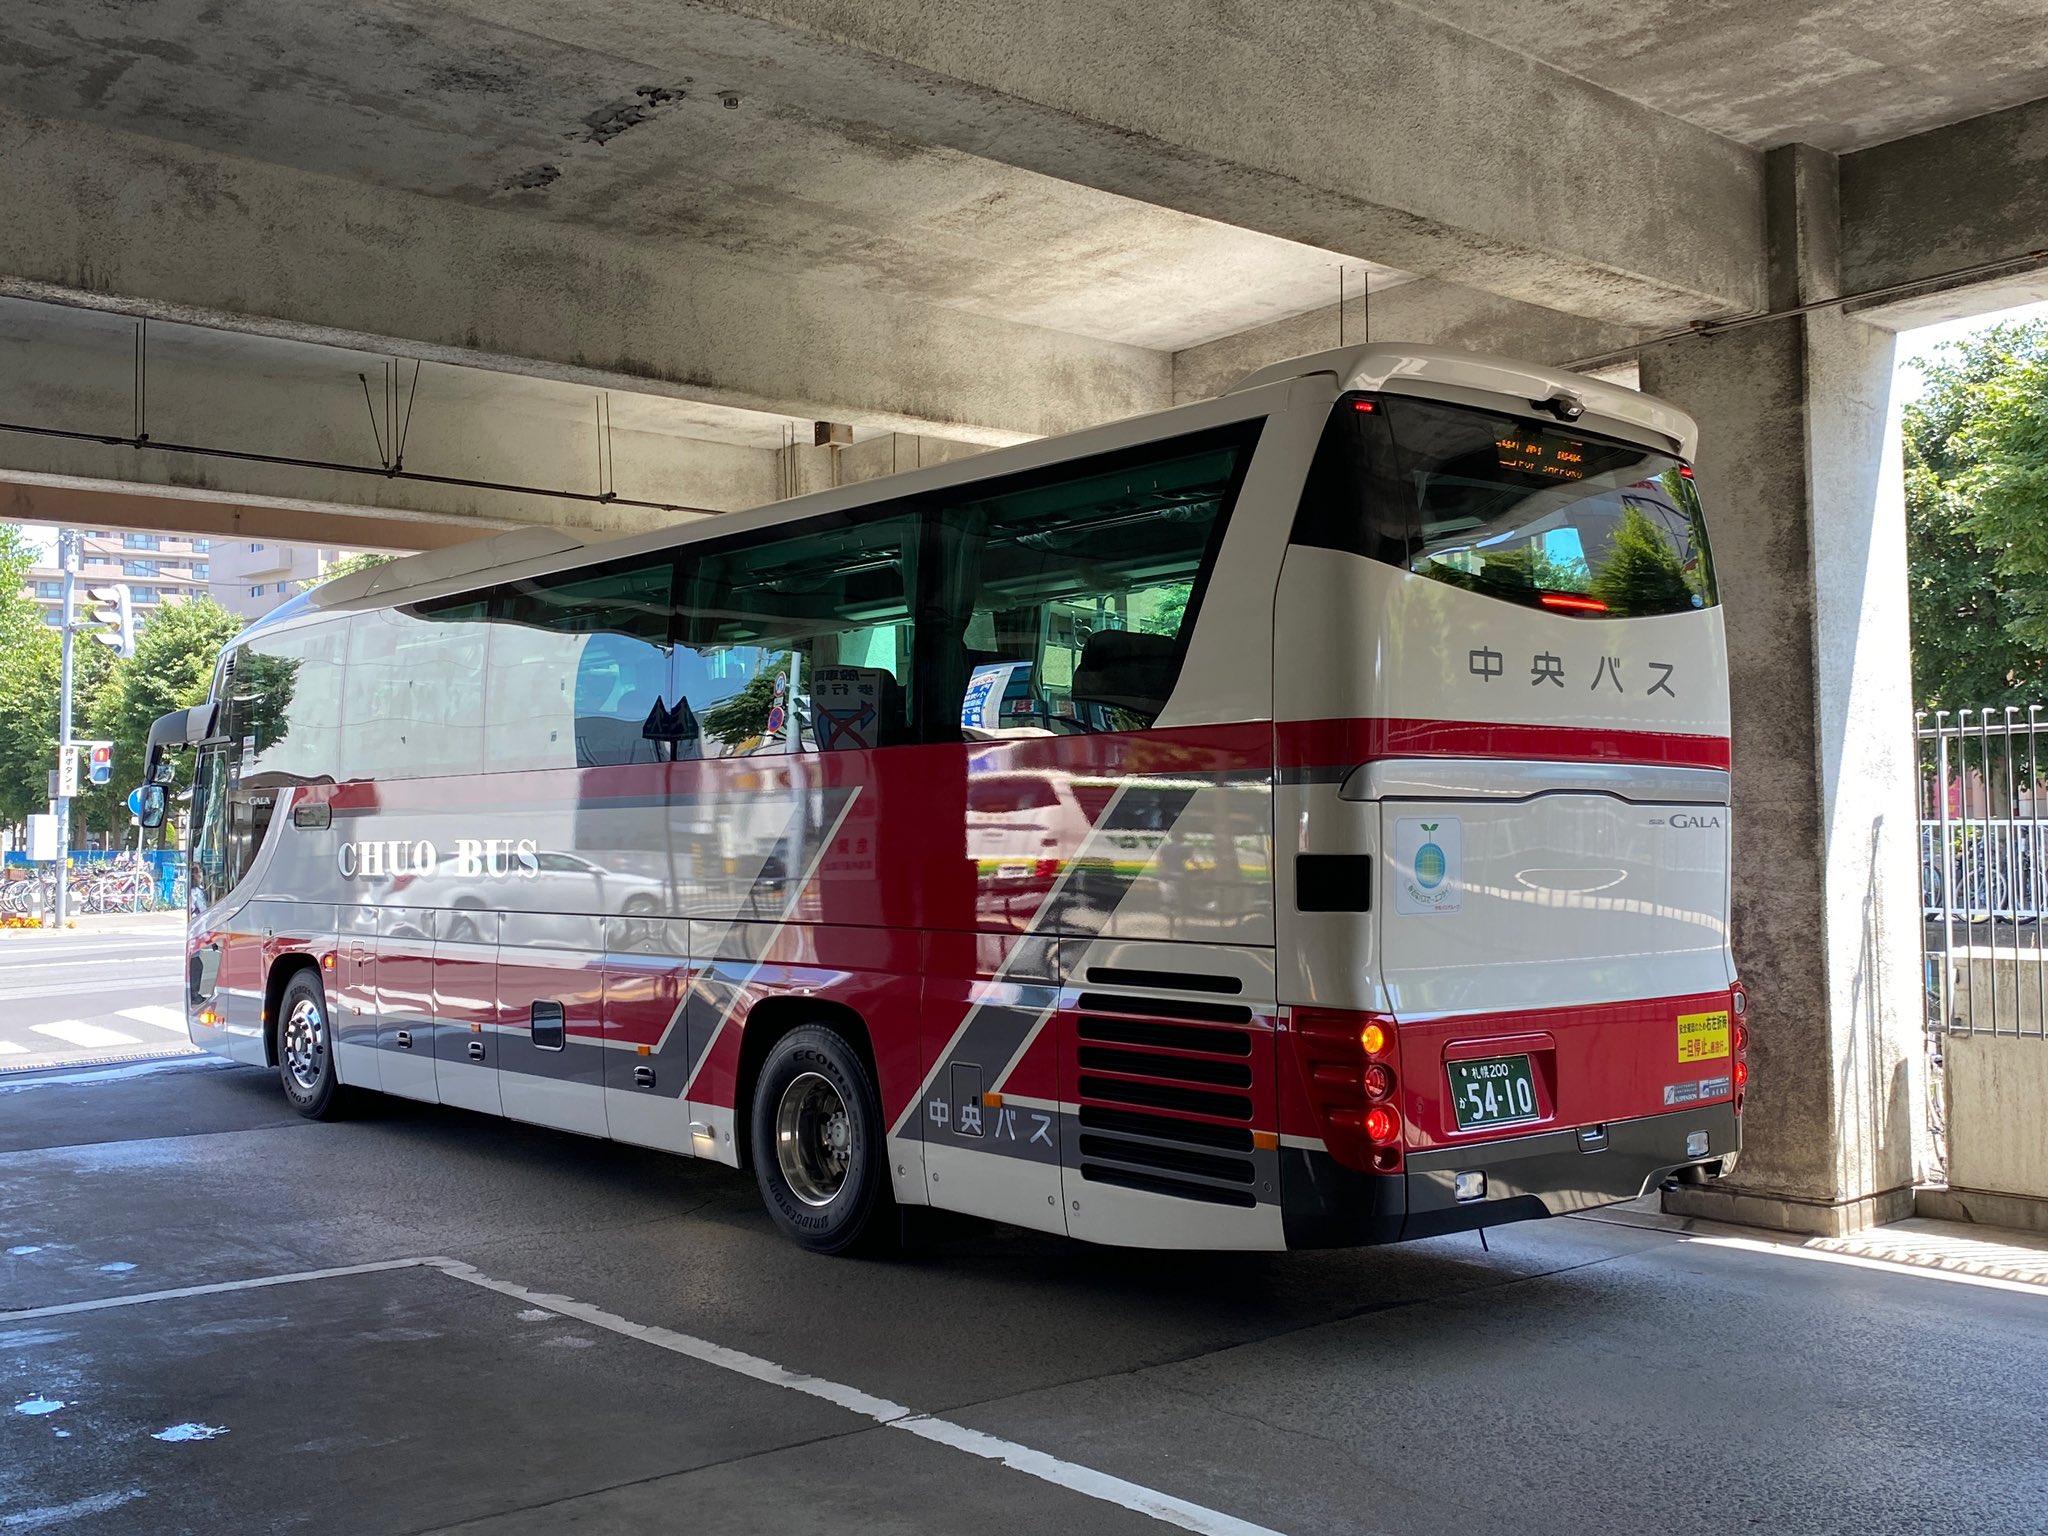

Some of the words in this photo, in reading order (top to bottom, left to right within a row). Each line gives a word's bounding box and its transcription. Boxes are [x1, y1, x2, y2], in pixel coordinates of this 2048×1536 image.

[1469, 645, 1676, 698] 中央バス
[248, 796, 271, 806] GALA
[1669, 813, 1720, 829] GALA
[338, 839, 438, 880] CHUO
[455, 839, 541, 881] BUS
[929, 1097, 1053, 1147] 中央バス
